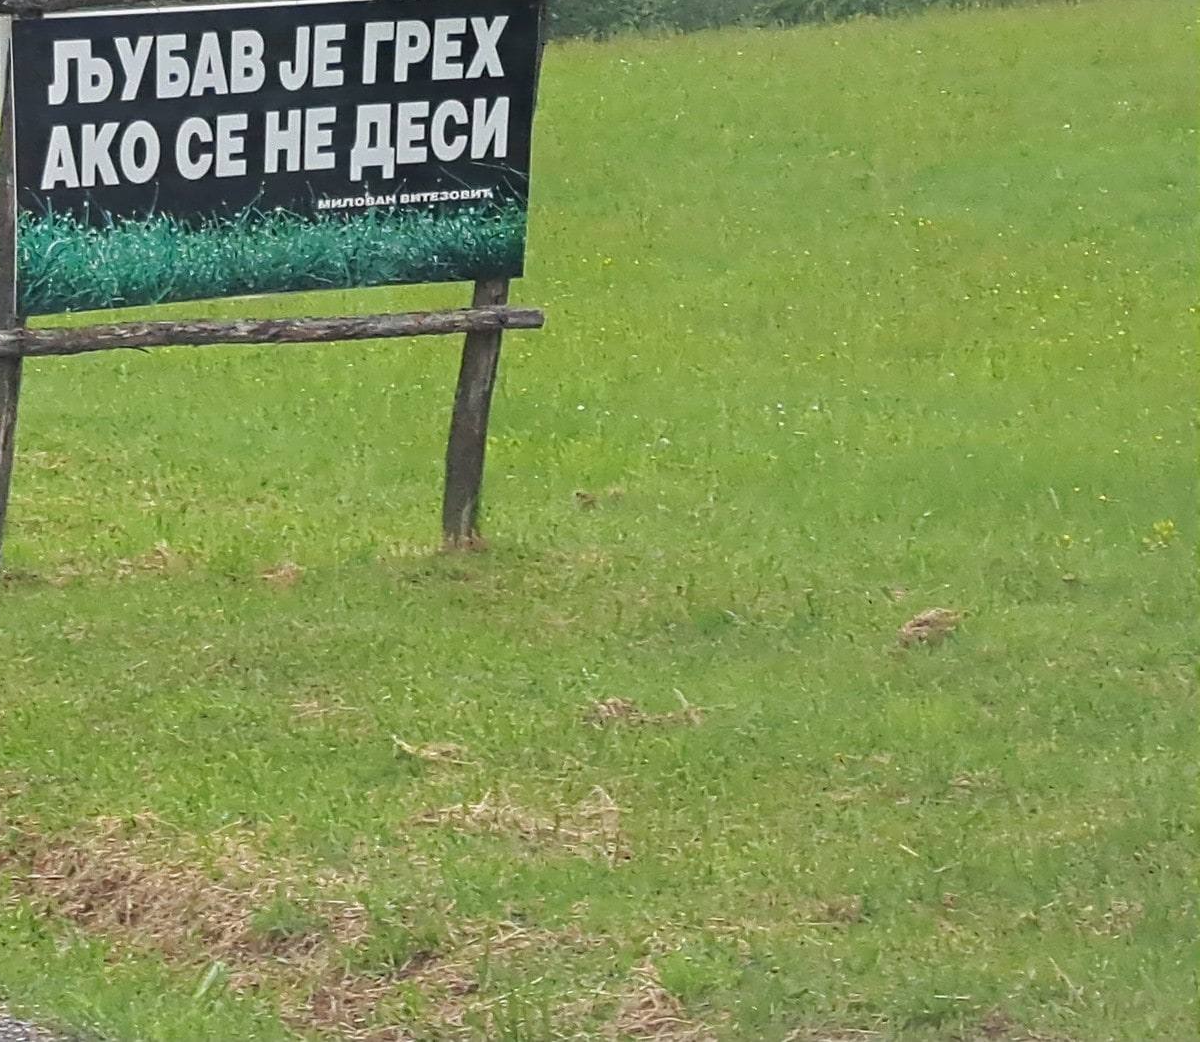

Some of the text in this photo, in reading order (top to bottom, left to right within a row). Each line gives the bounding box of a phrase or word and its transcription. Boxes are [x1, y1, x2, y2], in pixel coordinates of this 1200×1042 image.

[48, 15, 509, 105] ЉУБАВ ЈЕ ГРЕХ
[40, 97, 510, 190] АКО СЕ НЕ ДЕСИ
[318, 195, 396, 209] МИЛОВАН
